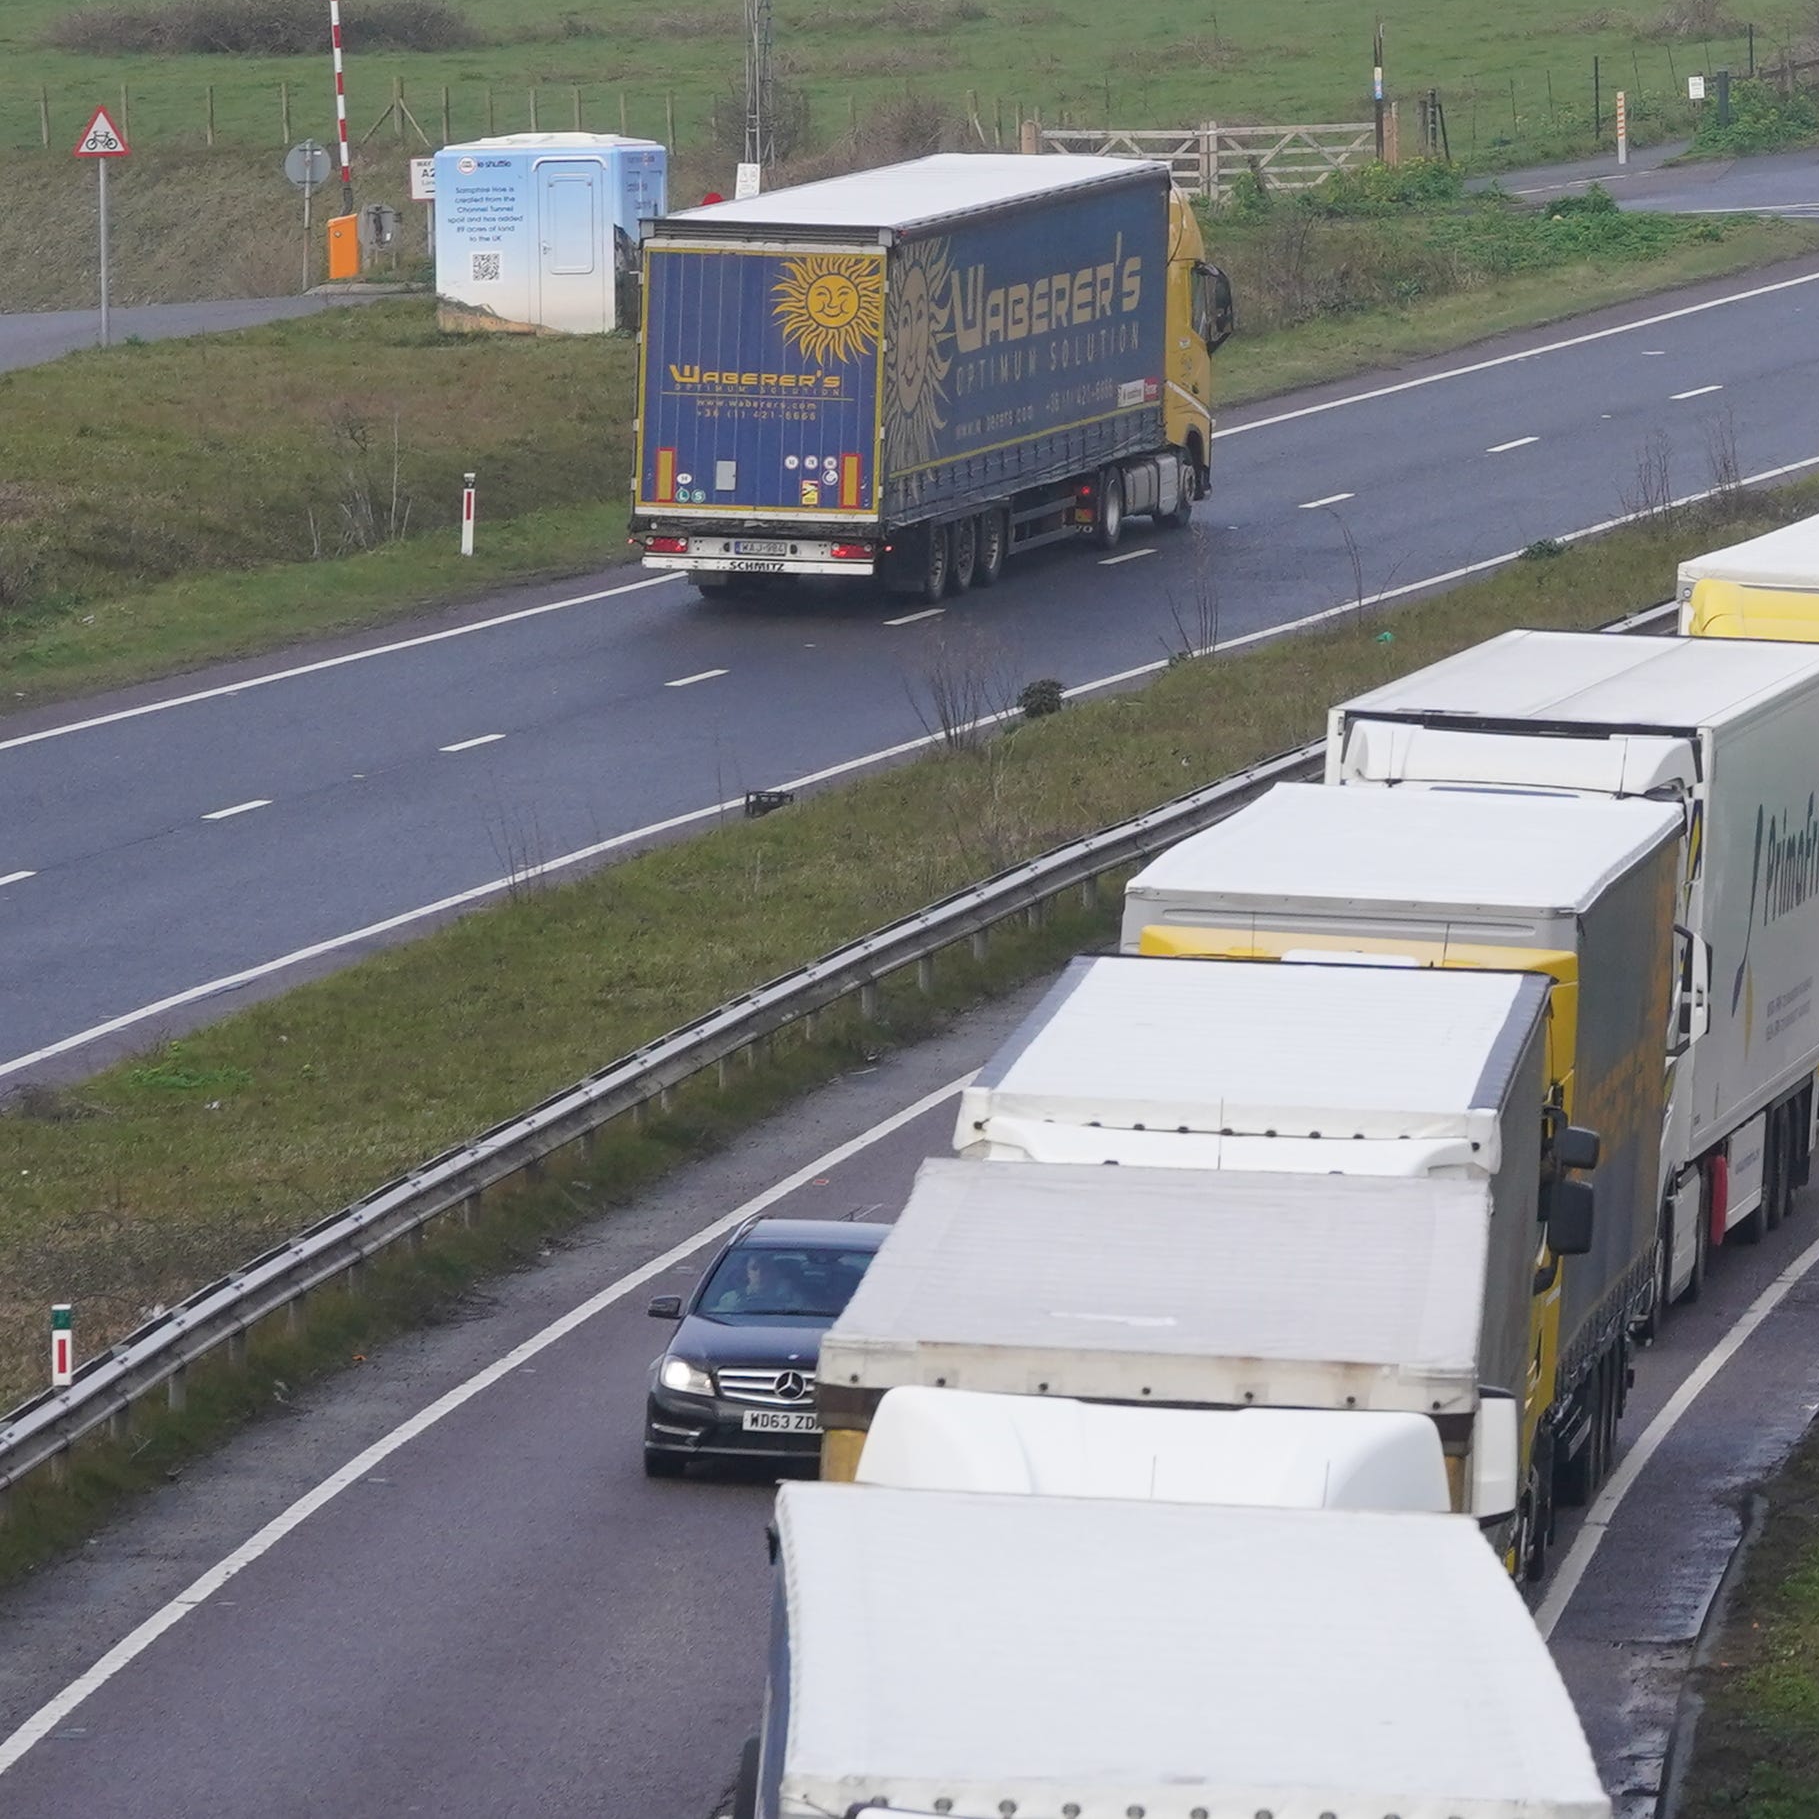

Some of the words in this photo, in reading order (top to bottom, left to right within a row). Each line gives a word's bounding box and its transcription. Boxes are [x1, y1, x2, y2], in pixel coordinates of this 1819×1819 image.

[951, 231, 1142, 353] WABERER'S
[956, 347, 1037, 396] OPTIMUM
[1050, 322, 1139, 371] SOLUTION
[669, 364, 841, 388] WABERER'S
[675, 384, 746, 393] OPTIMUM
[760, 386, 841, 396] SOLUTION
[697, 399, 817, 410] www.waberers.com
[729, 561, 785, 572] SCHMITZ
[749, 1412, 789, 1429] WD63
[794, 1415, 823, 1431] ZD
